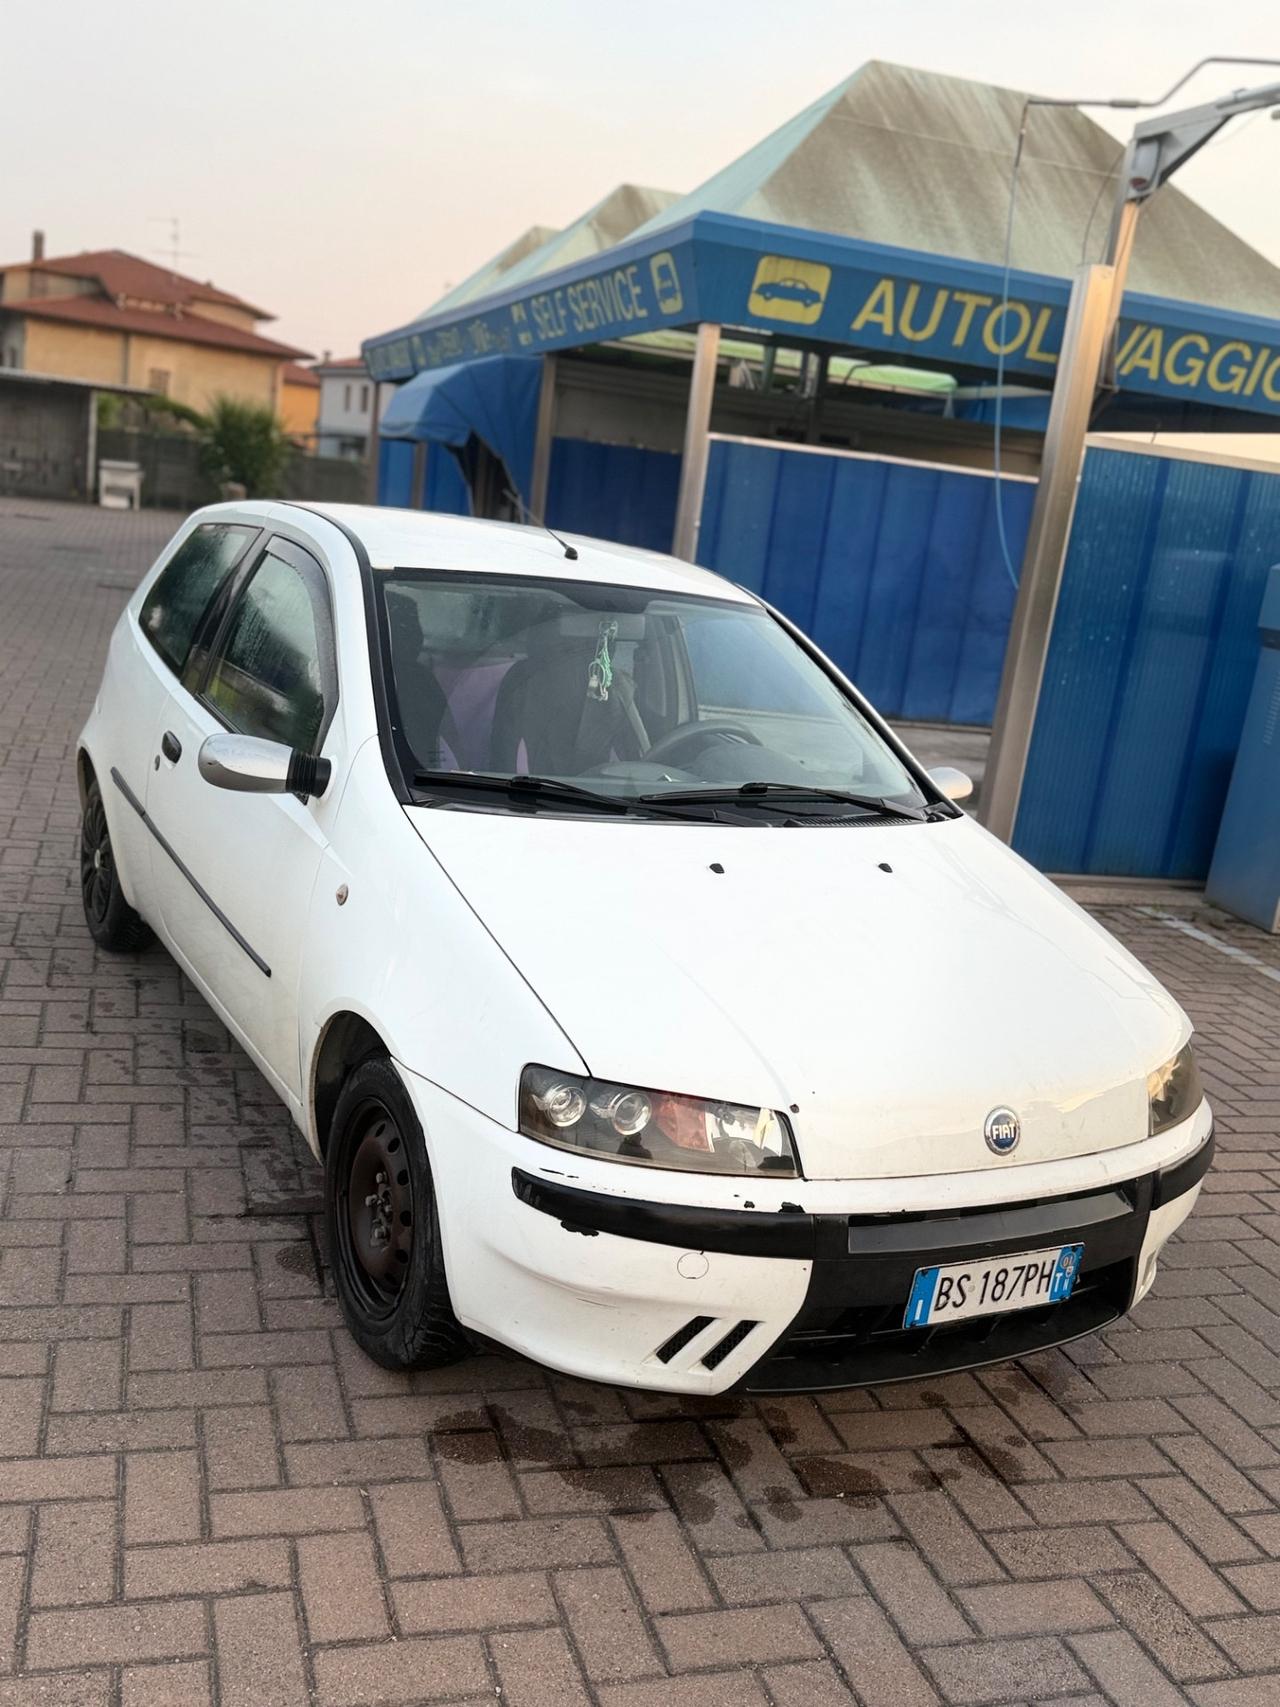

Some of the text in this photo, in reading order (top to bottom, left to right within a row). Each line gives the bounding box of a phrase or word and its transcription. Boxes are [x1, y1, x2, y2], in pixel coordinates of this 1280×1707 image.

[530, 290, 567, 341] SELF
[567, 265, 648, 333] SERVICE
[850, 278, 1280, 403] AUTOLAGGI
[992, 1122, 1016, 1140] FIAT
[934, 1259, 1056, 1312] BS 187PH
